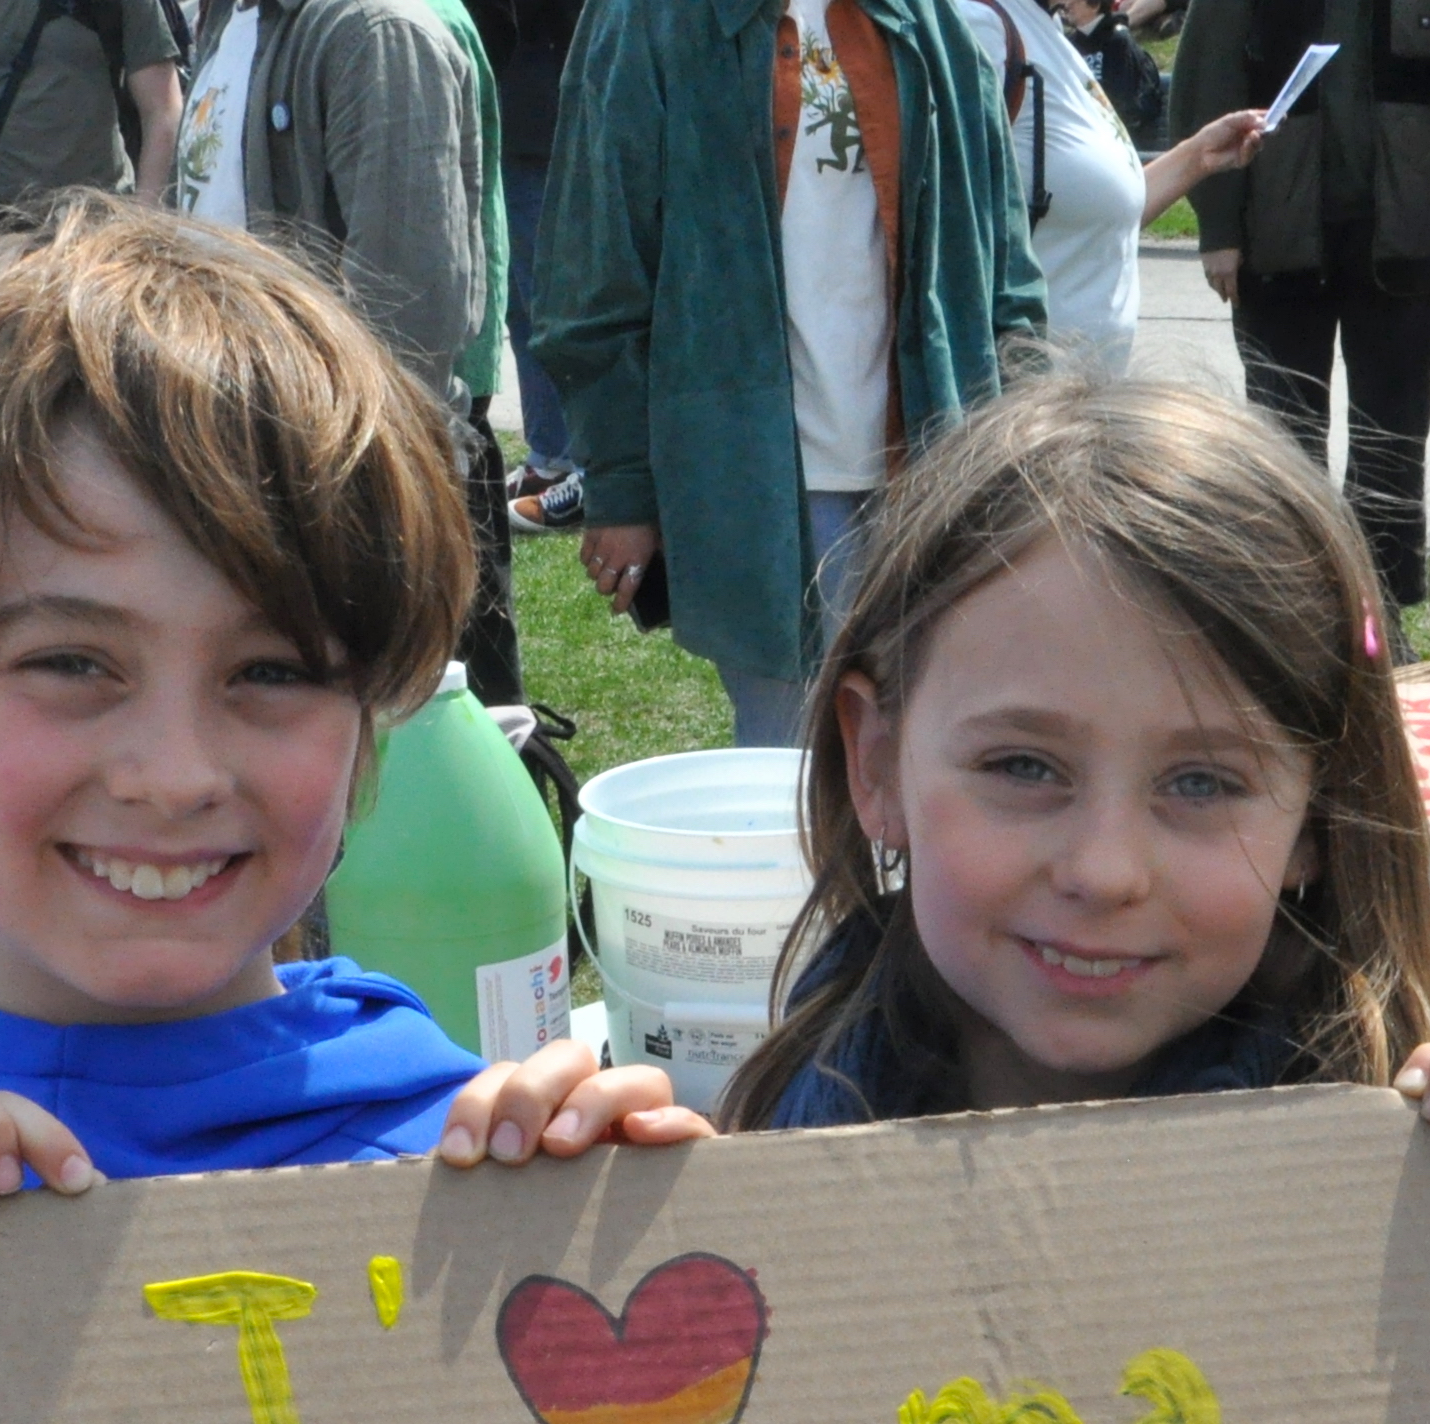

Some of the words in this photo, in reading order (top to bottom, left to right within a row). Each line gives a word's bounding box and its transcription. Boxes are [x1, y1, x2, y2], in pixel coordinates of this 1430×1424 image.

[624, 907, 653, 928] 1525
[691, 924, 729, 935] Saveurs
[732, 927, 745, 935] du
[747, 927, 767, 935] four
[530, 965, 547, 1050] ouachi
